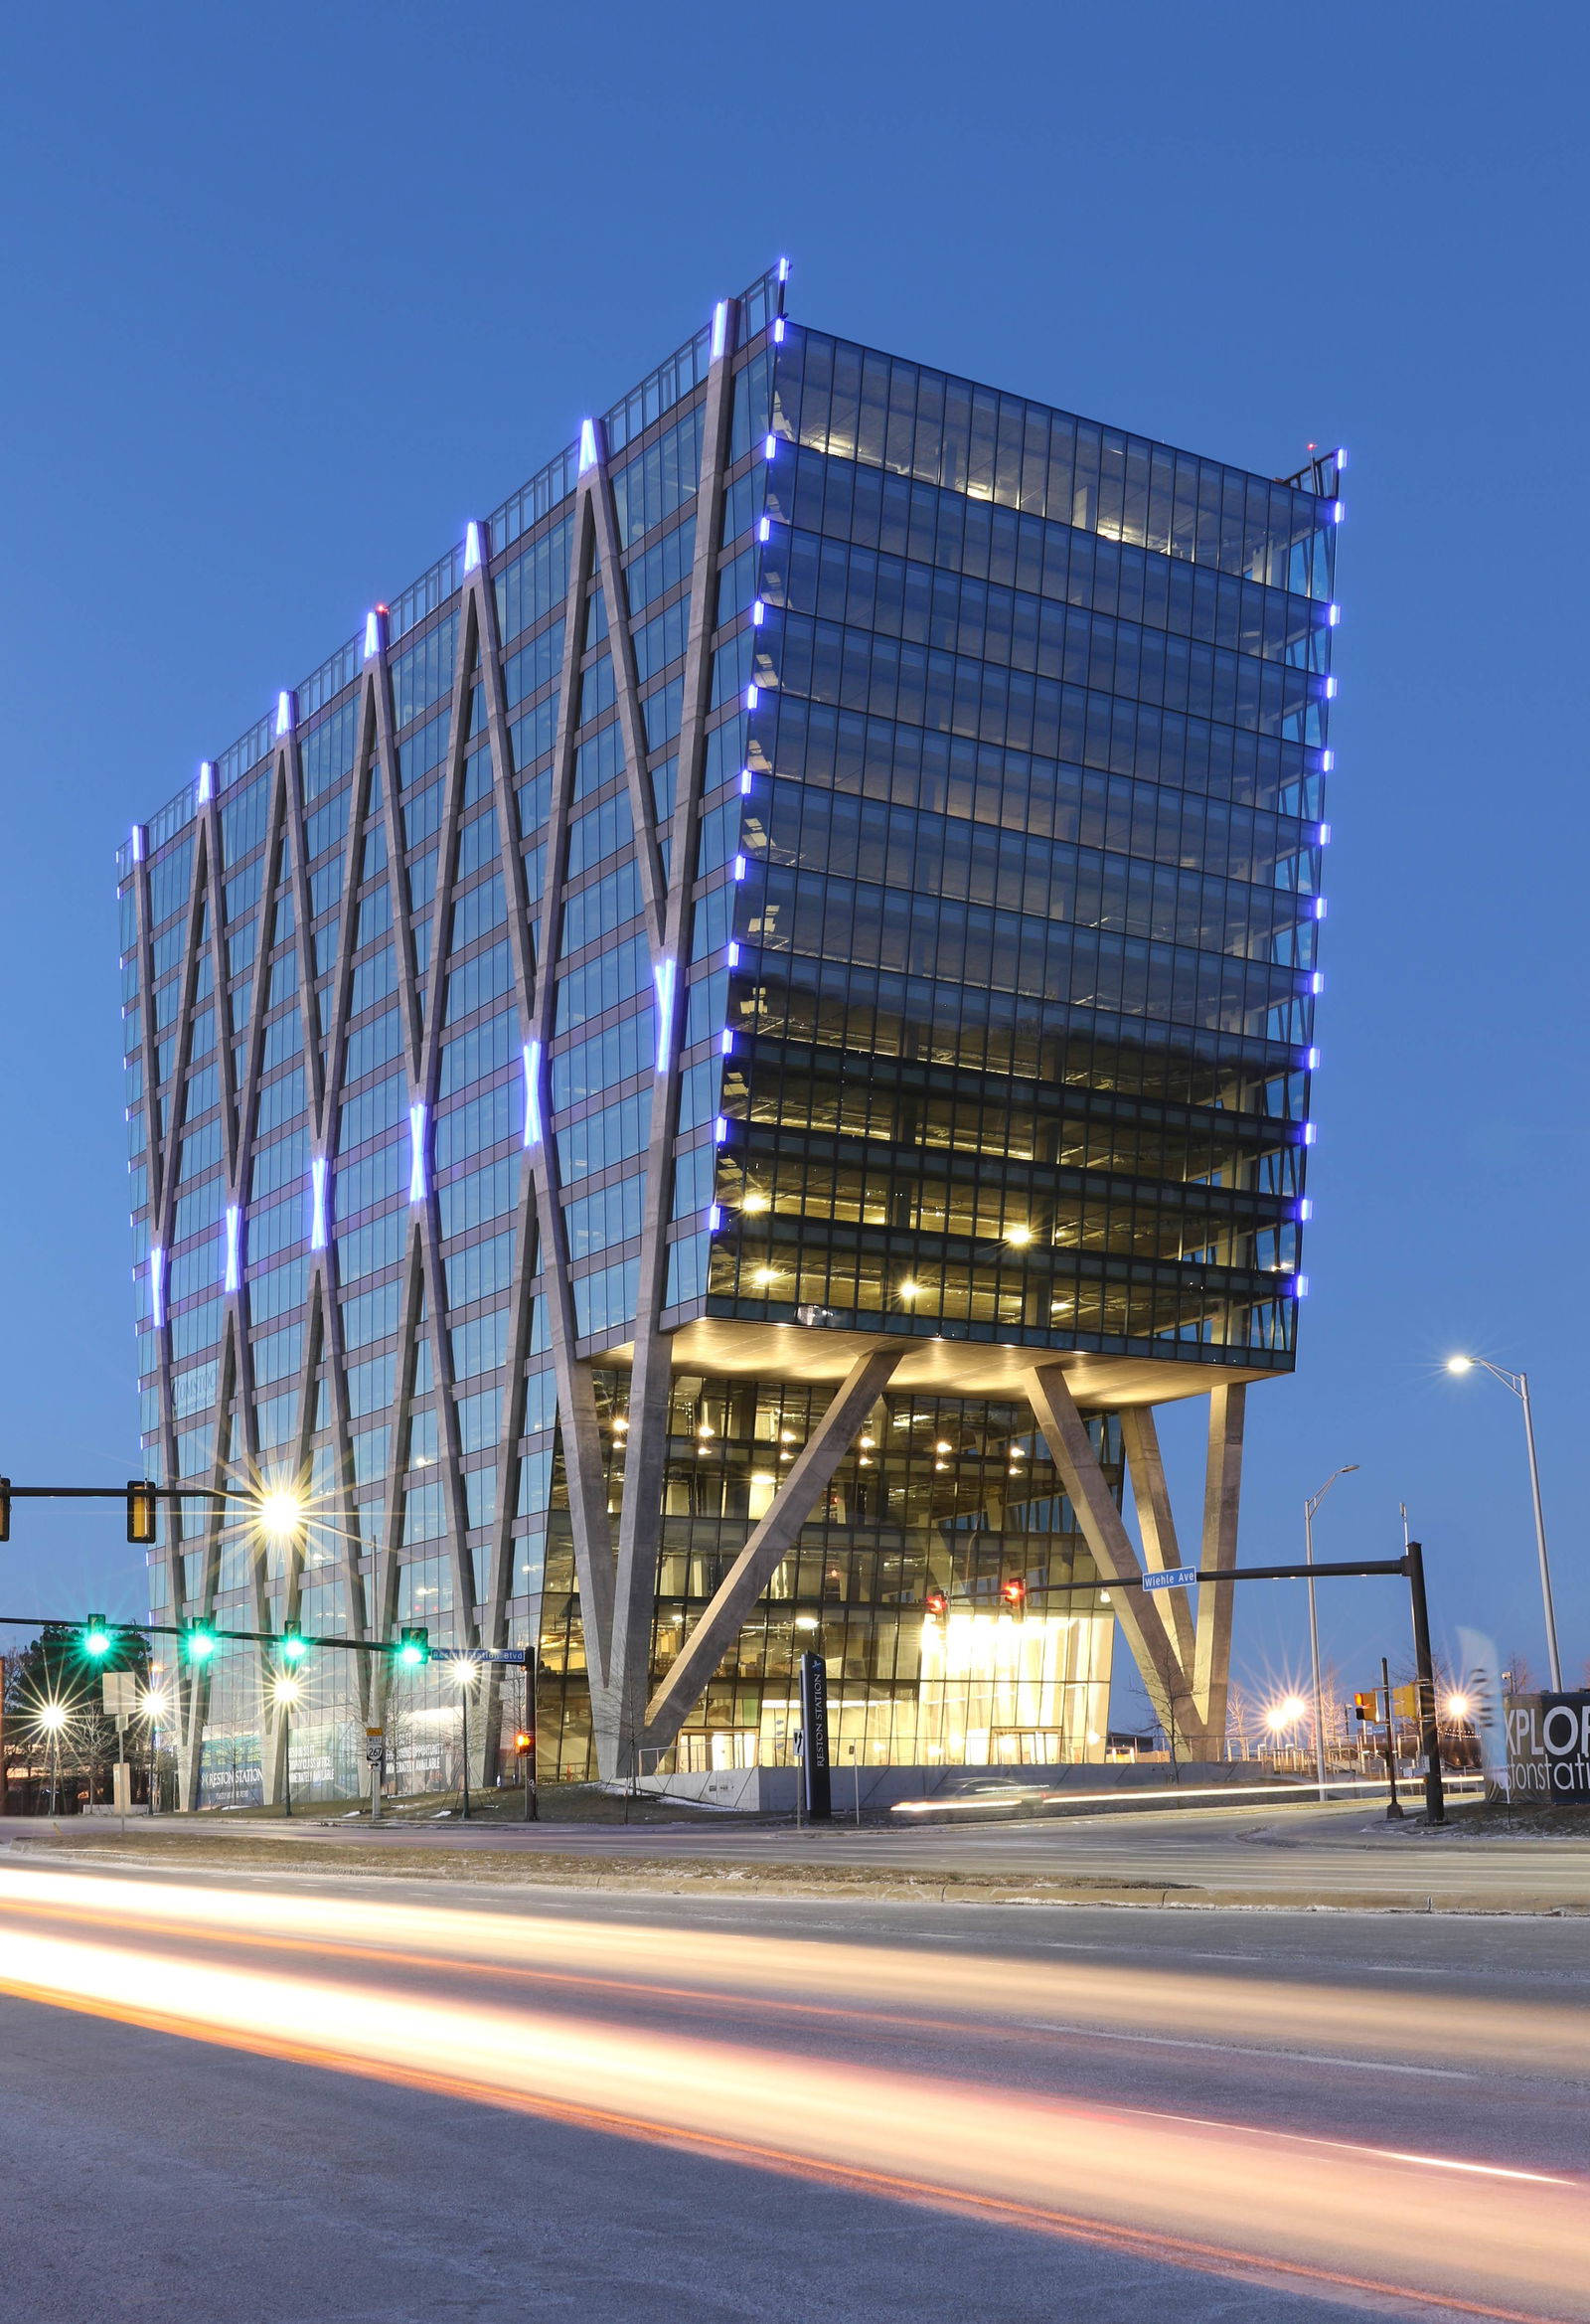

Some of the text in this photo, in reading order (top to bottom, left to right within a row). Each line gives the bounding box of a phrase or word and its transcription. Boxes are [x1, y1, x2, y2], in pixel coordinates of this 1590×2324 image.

[1145, 1573, 1194, 1586] Wiehle Ave
[814, 1674, 825, 1766] RESTON STATION
[369, 1747, 382, 1757] 267
[209, 1767, 263, 1787] RESTON STATION
